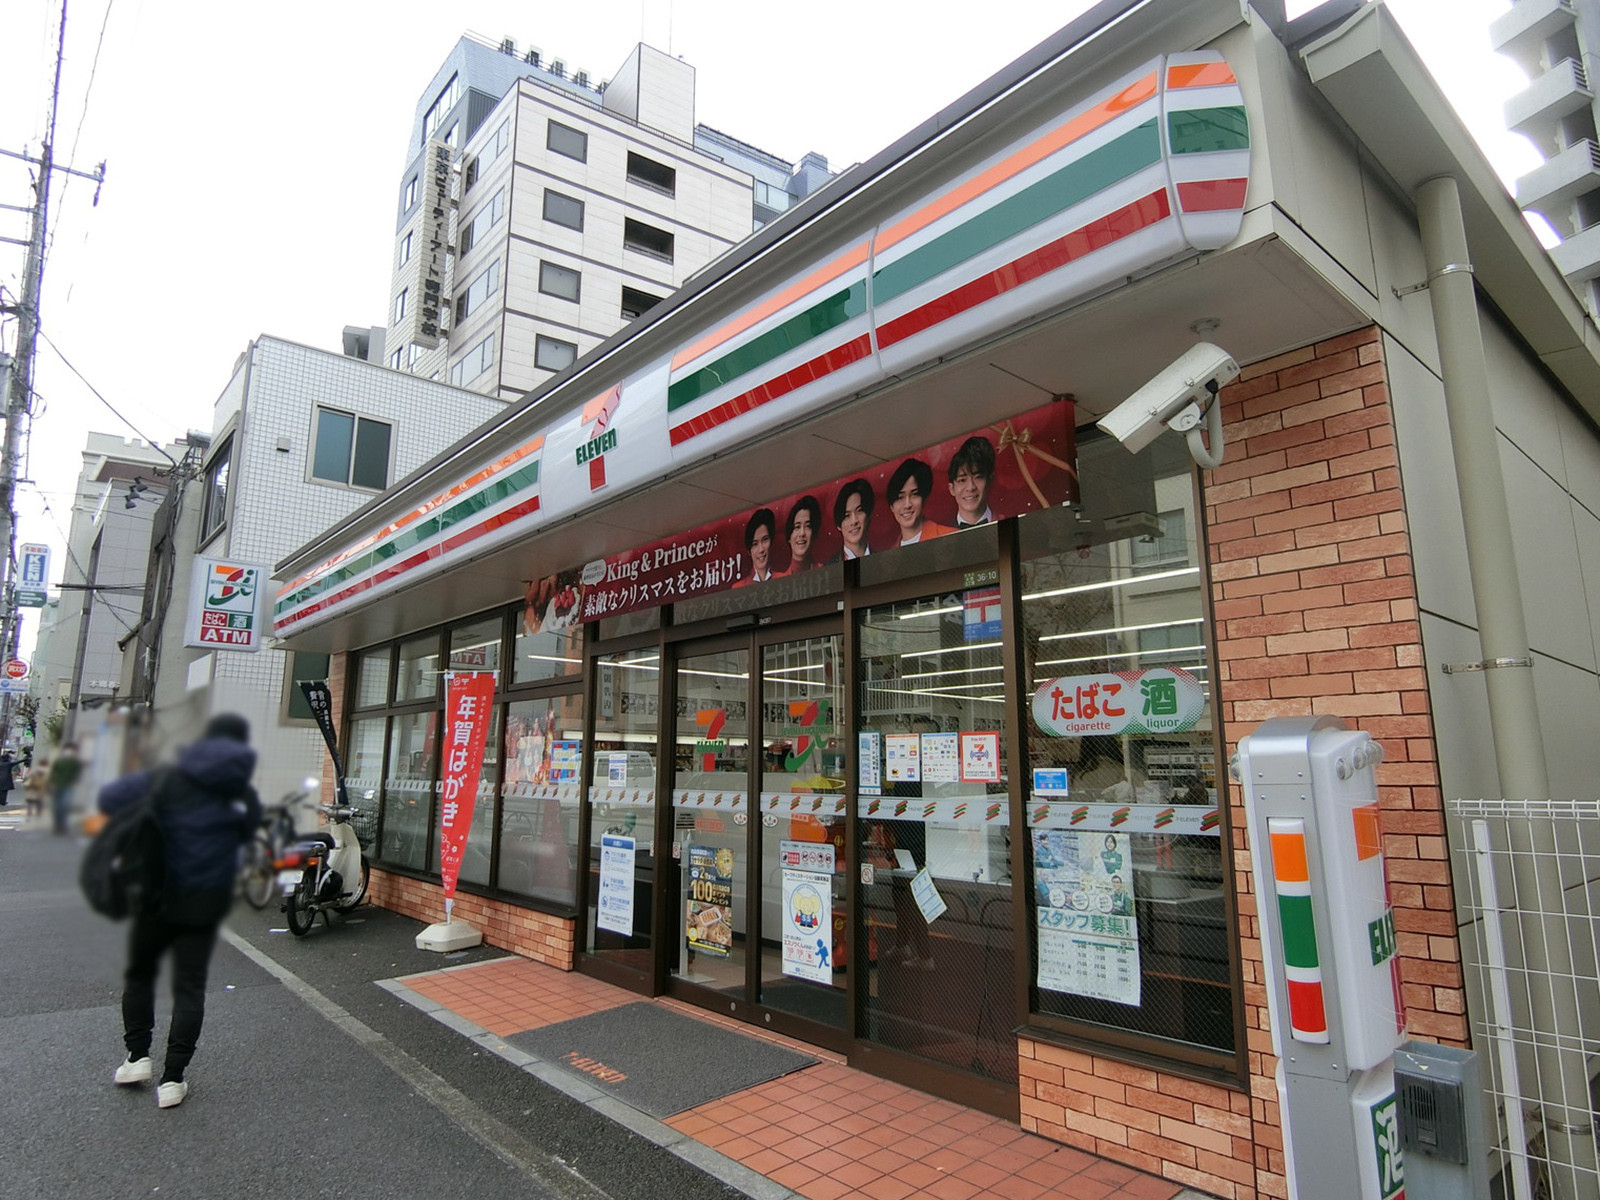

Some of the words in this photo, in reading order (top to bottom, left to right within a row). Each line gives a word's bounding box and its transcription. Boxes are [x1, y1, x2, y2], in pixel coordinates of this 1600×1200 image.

[606, 557, 641, 584] King
[204, 612, 226, 626] たばこ
[233, 615, 248, 628] 酒
[203, 629, 248, 644] ATM
[1050, 682, 1126, 722] たばこ
[1139, 677, 1179, 717] 酒
[1065, 720, 1112, 734] cigarette
[1146, 717, 1180, 731] liquor
[442, 694, 477, 827] 年賀はがき
[690, 879, 713, 902] 100
[1039, 909, 1131, 938] スタッフ募集!
